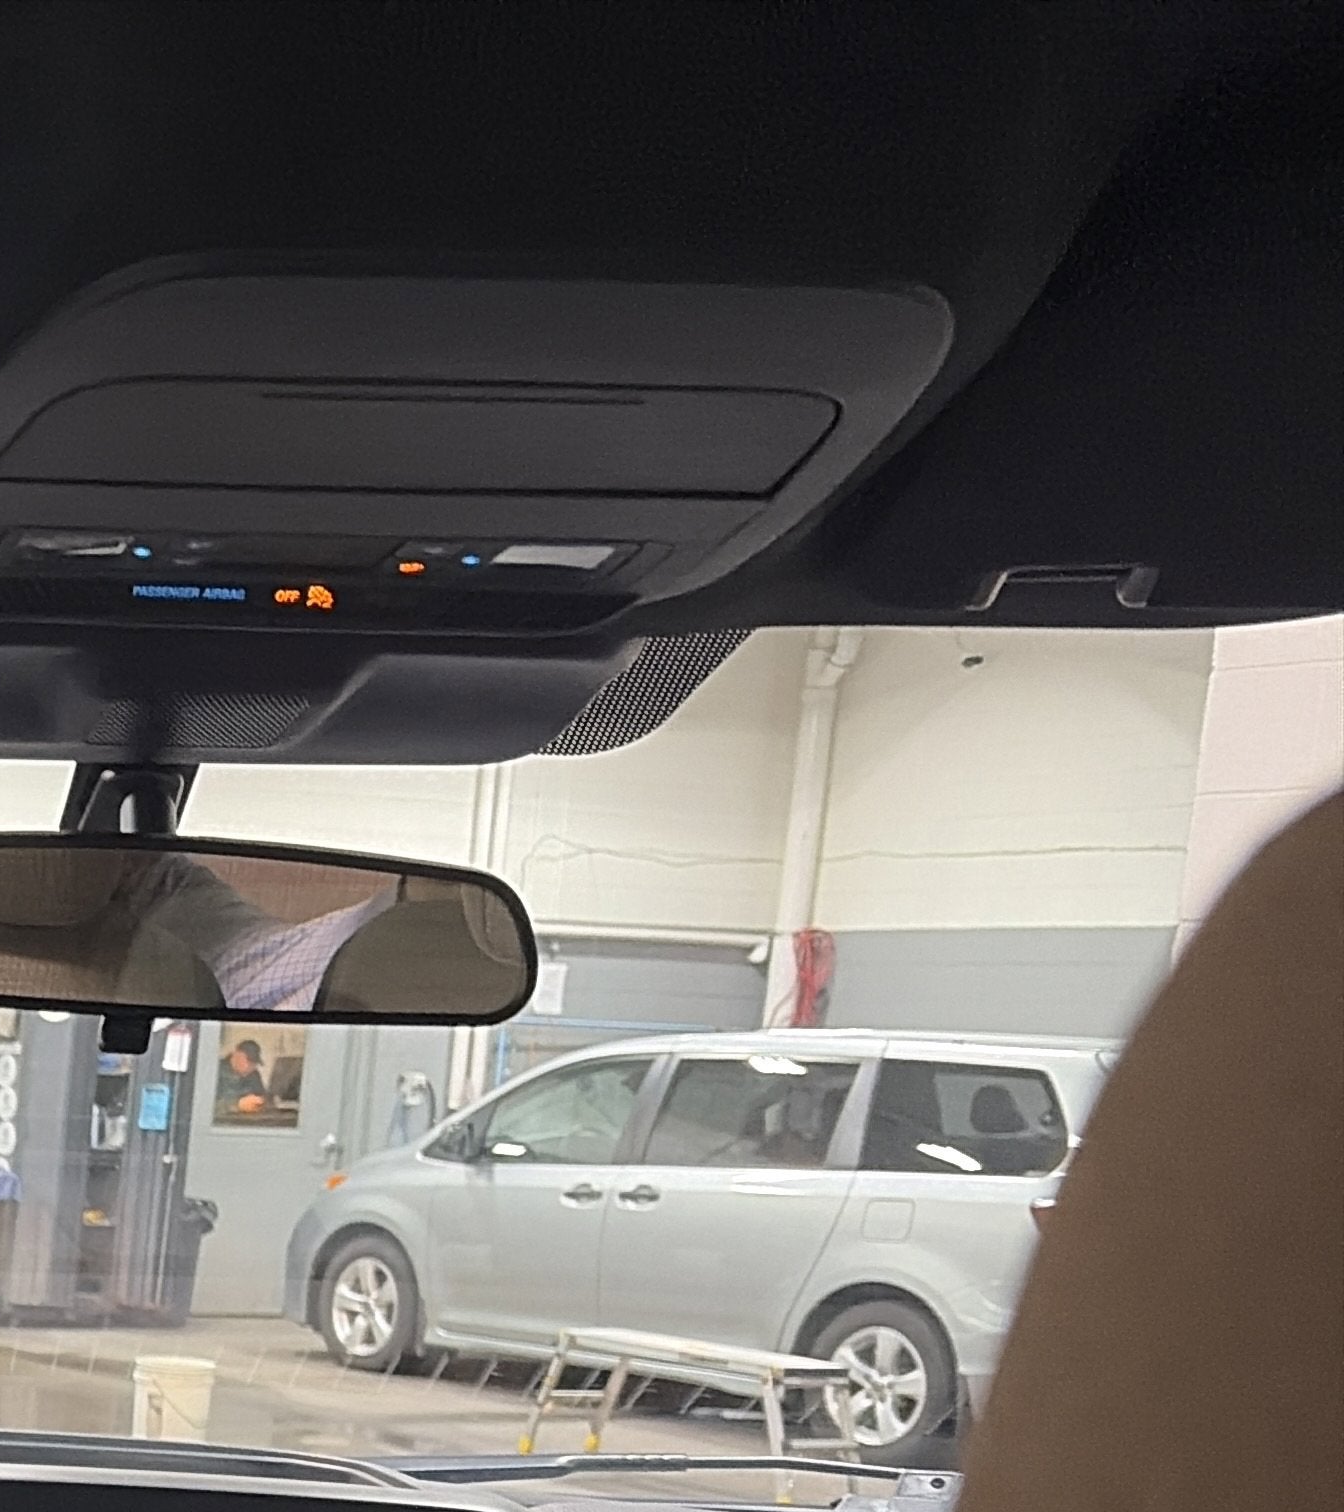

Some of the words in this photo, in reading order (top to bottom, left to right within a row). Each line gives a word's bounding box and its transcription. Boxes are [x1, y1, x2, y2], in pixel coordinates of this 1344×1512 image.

[132, 585, 200, 599] PASSENGER
[202, 588, 246, 601] AIRBAG
[274, 589, 301, 603] OFF
